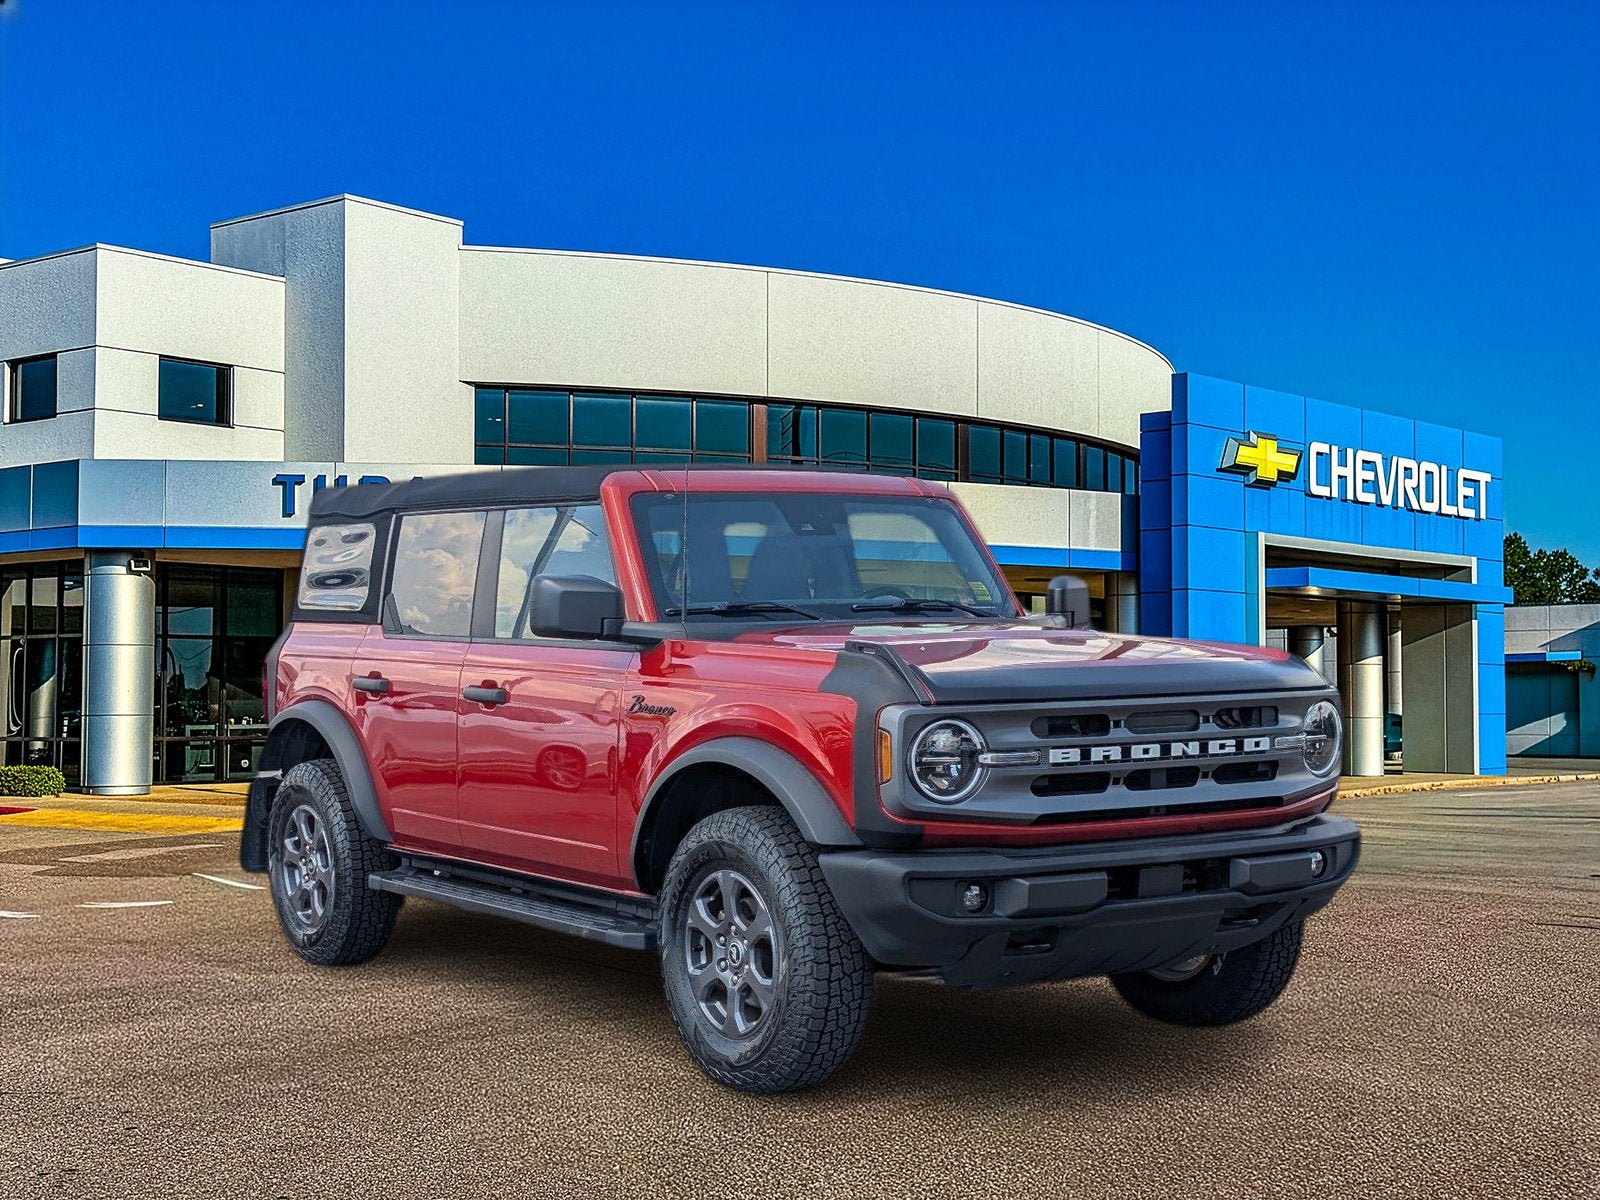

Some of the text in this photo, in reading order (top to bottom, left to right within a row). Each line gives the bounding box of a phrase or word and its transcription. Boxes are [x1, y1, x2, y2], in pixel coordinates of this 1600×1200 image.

[1308, 441, 1492, 520] CHEVROLET
[626, 695, 677, 716] Bronco
[1049, 736, 1270, 763] BRONCO
